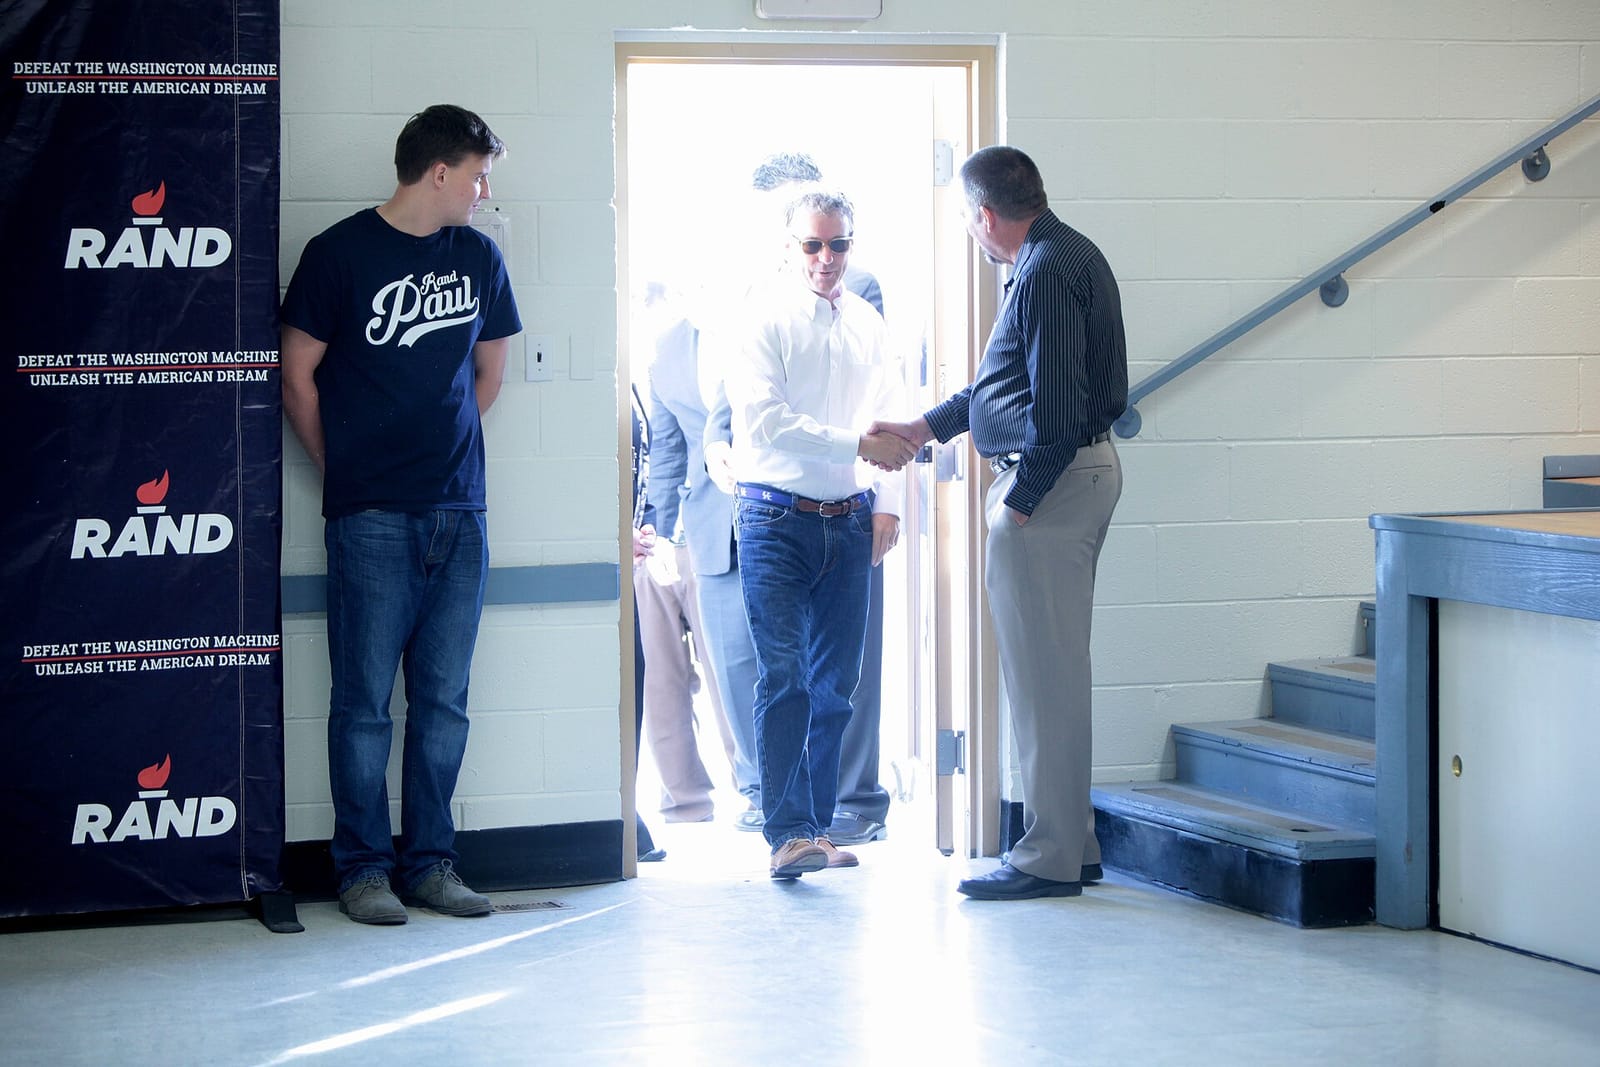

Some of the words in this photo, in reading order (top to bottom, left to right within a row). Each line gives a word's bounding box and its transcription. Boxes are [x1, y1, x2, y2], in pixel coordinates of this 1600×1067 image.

[13, 62, 71, 74] DEFEAT
[75, 62, 104, 74] THE
[107, 62, 206, 75] WASHINGTON
[209, 63, 278, 76] MACHINE
[25, 81, 96, 94] UNLEASH
[99, 81, 129, 94] THE
[132, 81, 211, 95] AMERICAN
[213, 82, 267, 95] DREAM
[64, 227, 232, 269] RAND
[420, 269, 459, 296] Rand
[365, 273, 480, 347] Paul
[18, 354, 74, 368] DEFEAT
[76, 353, 108, 366] THE
[111, 351, 209, 366] WASHINGTON
[211, 350, 279, 364] MACHINE
[29, 373, 100, 386] UNLEASH
[102, 372, 134, 386] THE
[137, 370, 214, 385] AMERICAN
[216, 369, 268, 383] DREAM
[70, 513, 234, 560] RAND
[23, 643, 79, 658] DEFEAT
[81, 641, 112, 655] THE
[115, 636, 211, 653] WASHINGTON
[213, 634, 280, 649] MACHINE
[34, 661, 104, 676] UNLEASH
[106, 659, 137, 673] THE
[140, 655, 215, 671] AMERICAN
[218, 653, 271, 667] DREAM
[71, 796, 237, 845] RAND
